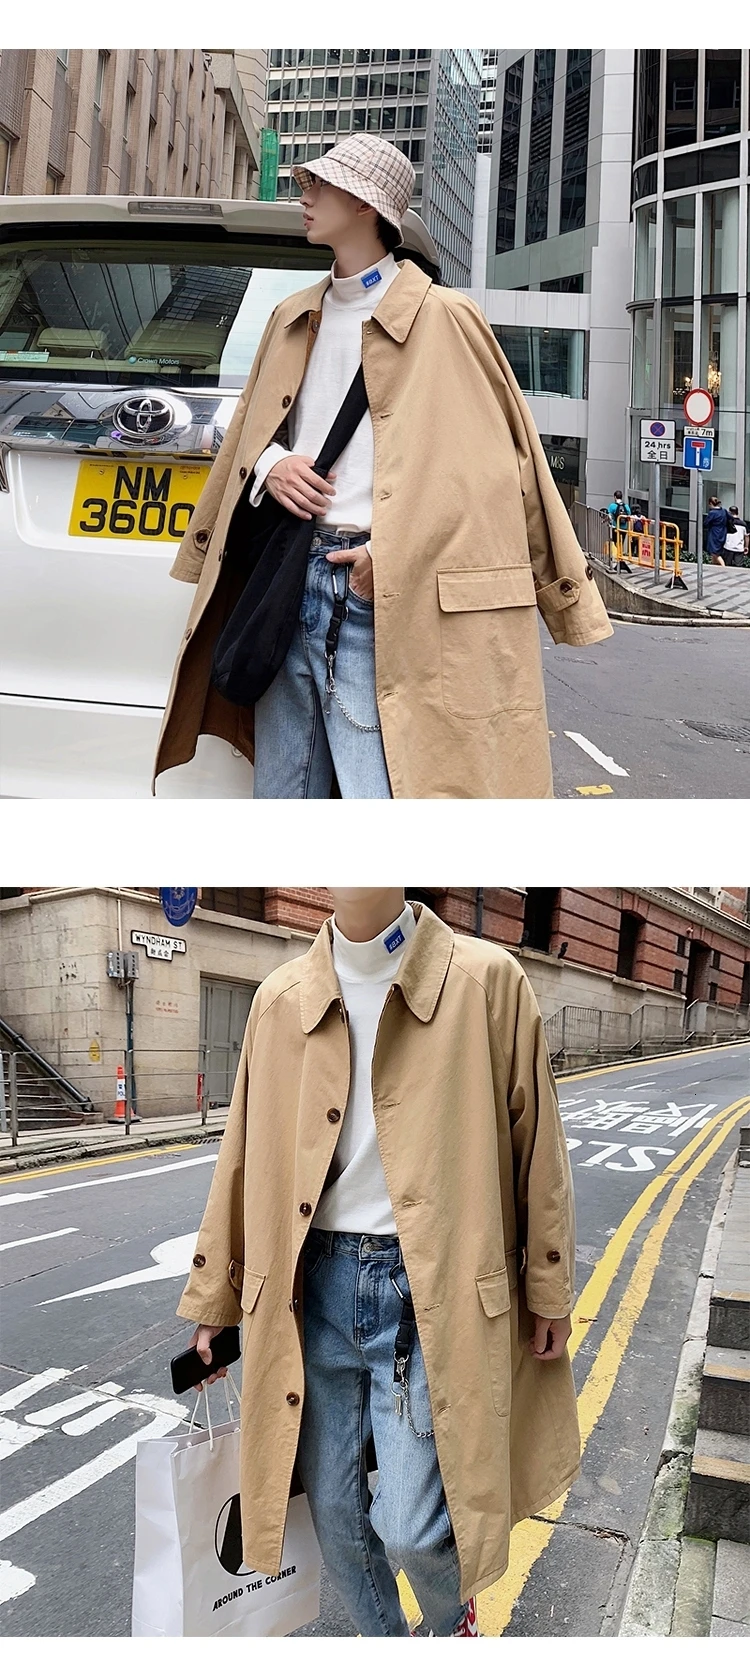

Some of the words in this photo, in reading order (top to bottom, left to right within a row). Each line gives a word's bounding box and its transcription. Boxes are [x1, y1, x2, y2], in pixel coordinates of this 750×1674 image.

[657, 442, 671, 450] hrs
[701, 429, 713, 437] 7m
[647, 450, 668, 460] 全日
[113, 466, 172, 501] NM
[79, 498, 196, 538] 3600
[134, 933, 171, 948] WYNDHAM
[173, 940, 183, 950] ST
[560, 1099, 719, 1137] 慢駛
[212, 1587, 244, 1612] AROUND
[246, 1578, 263, 1593] THE
[265, 1565, 297, 1585] CORNER
